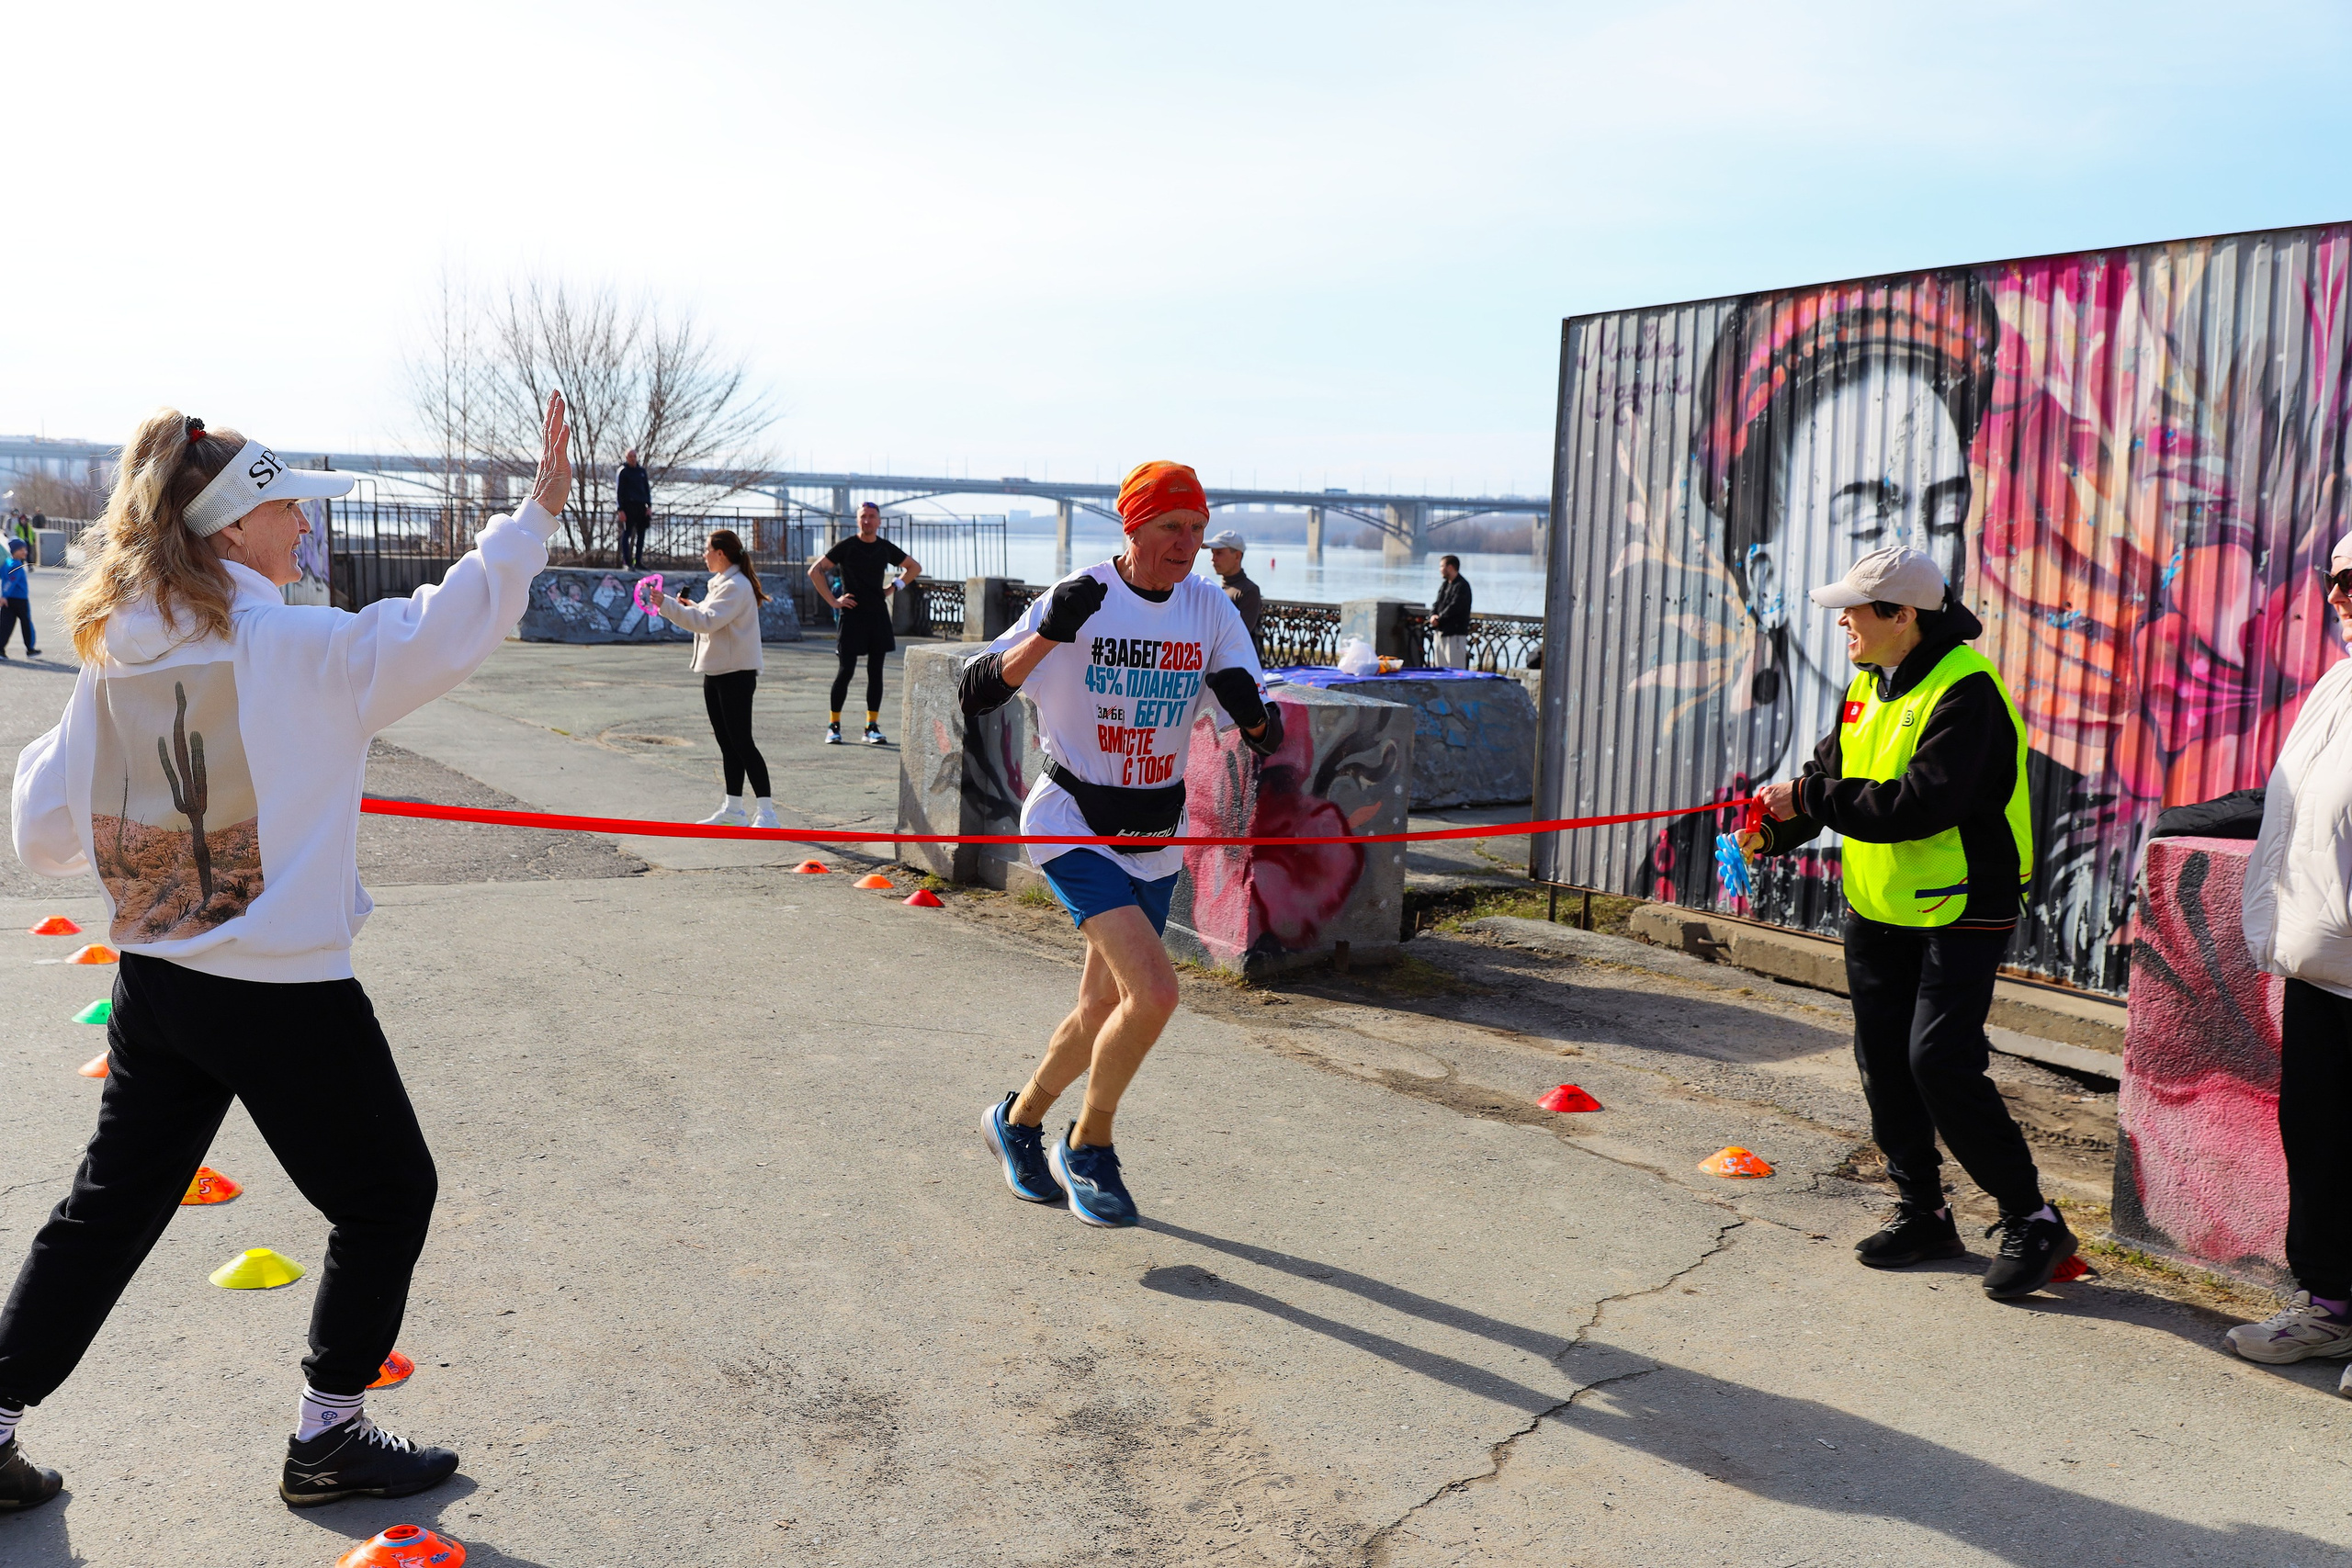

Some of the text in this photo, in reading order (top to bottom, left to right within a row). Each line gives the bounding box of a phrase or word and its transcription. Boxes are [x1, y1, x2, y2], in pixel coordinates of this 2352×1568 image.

[1091, 637, 1203, 671] #ЗАБЕГ2025
[1085, 664, 1123, 695] 45%
[1134, 700, 1188, 728] БЕГУТ
[1123, 757, 1134, 786] С
